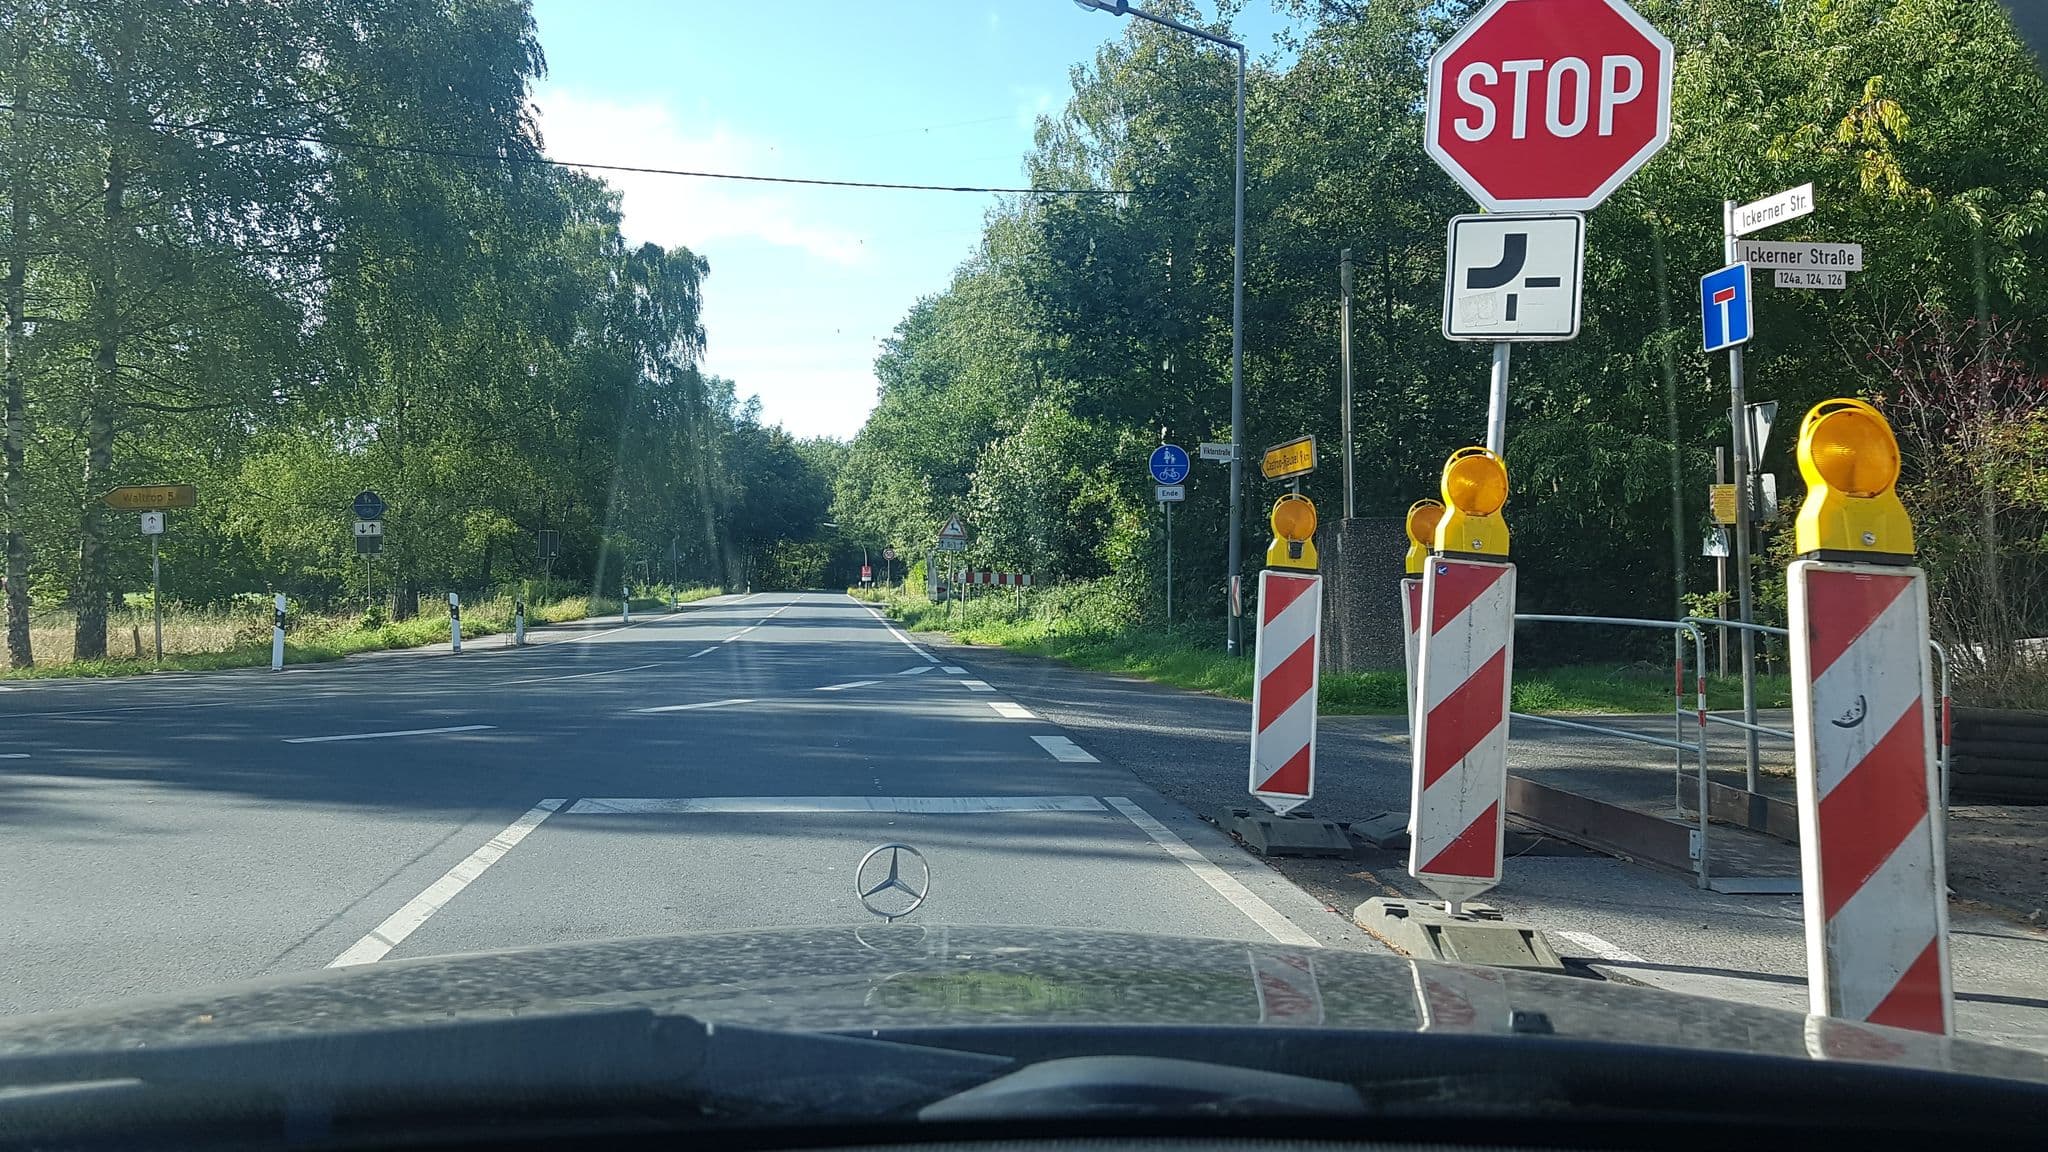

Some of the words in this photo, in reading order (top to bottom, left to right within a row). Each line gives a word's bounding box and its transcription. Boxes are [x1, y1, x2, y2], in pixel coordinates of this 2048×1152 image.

[1453, 54, 1644, 142] STOP
[1742, 202, 1786, 228] Ickerner
[1790, 194, 1808, 212] Str.
[1746, 246, 1803, 264] Ickerner
[1810, 248, 1855, 266] Straße
[1827, 274, 1843, 286] 126
[123, 493, 164, 504] Waltrop
[167, 491, 174, 501] 5
[1161, 489, 1179, 497] Ende
